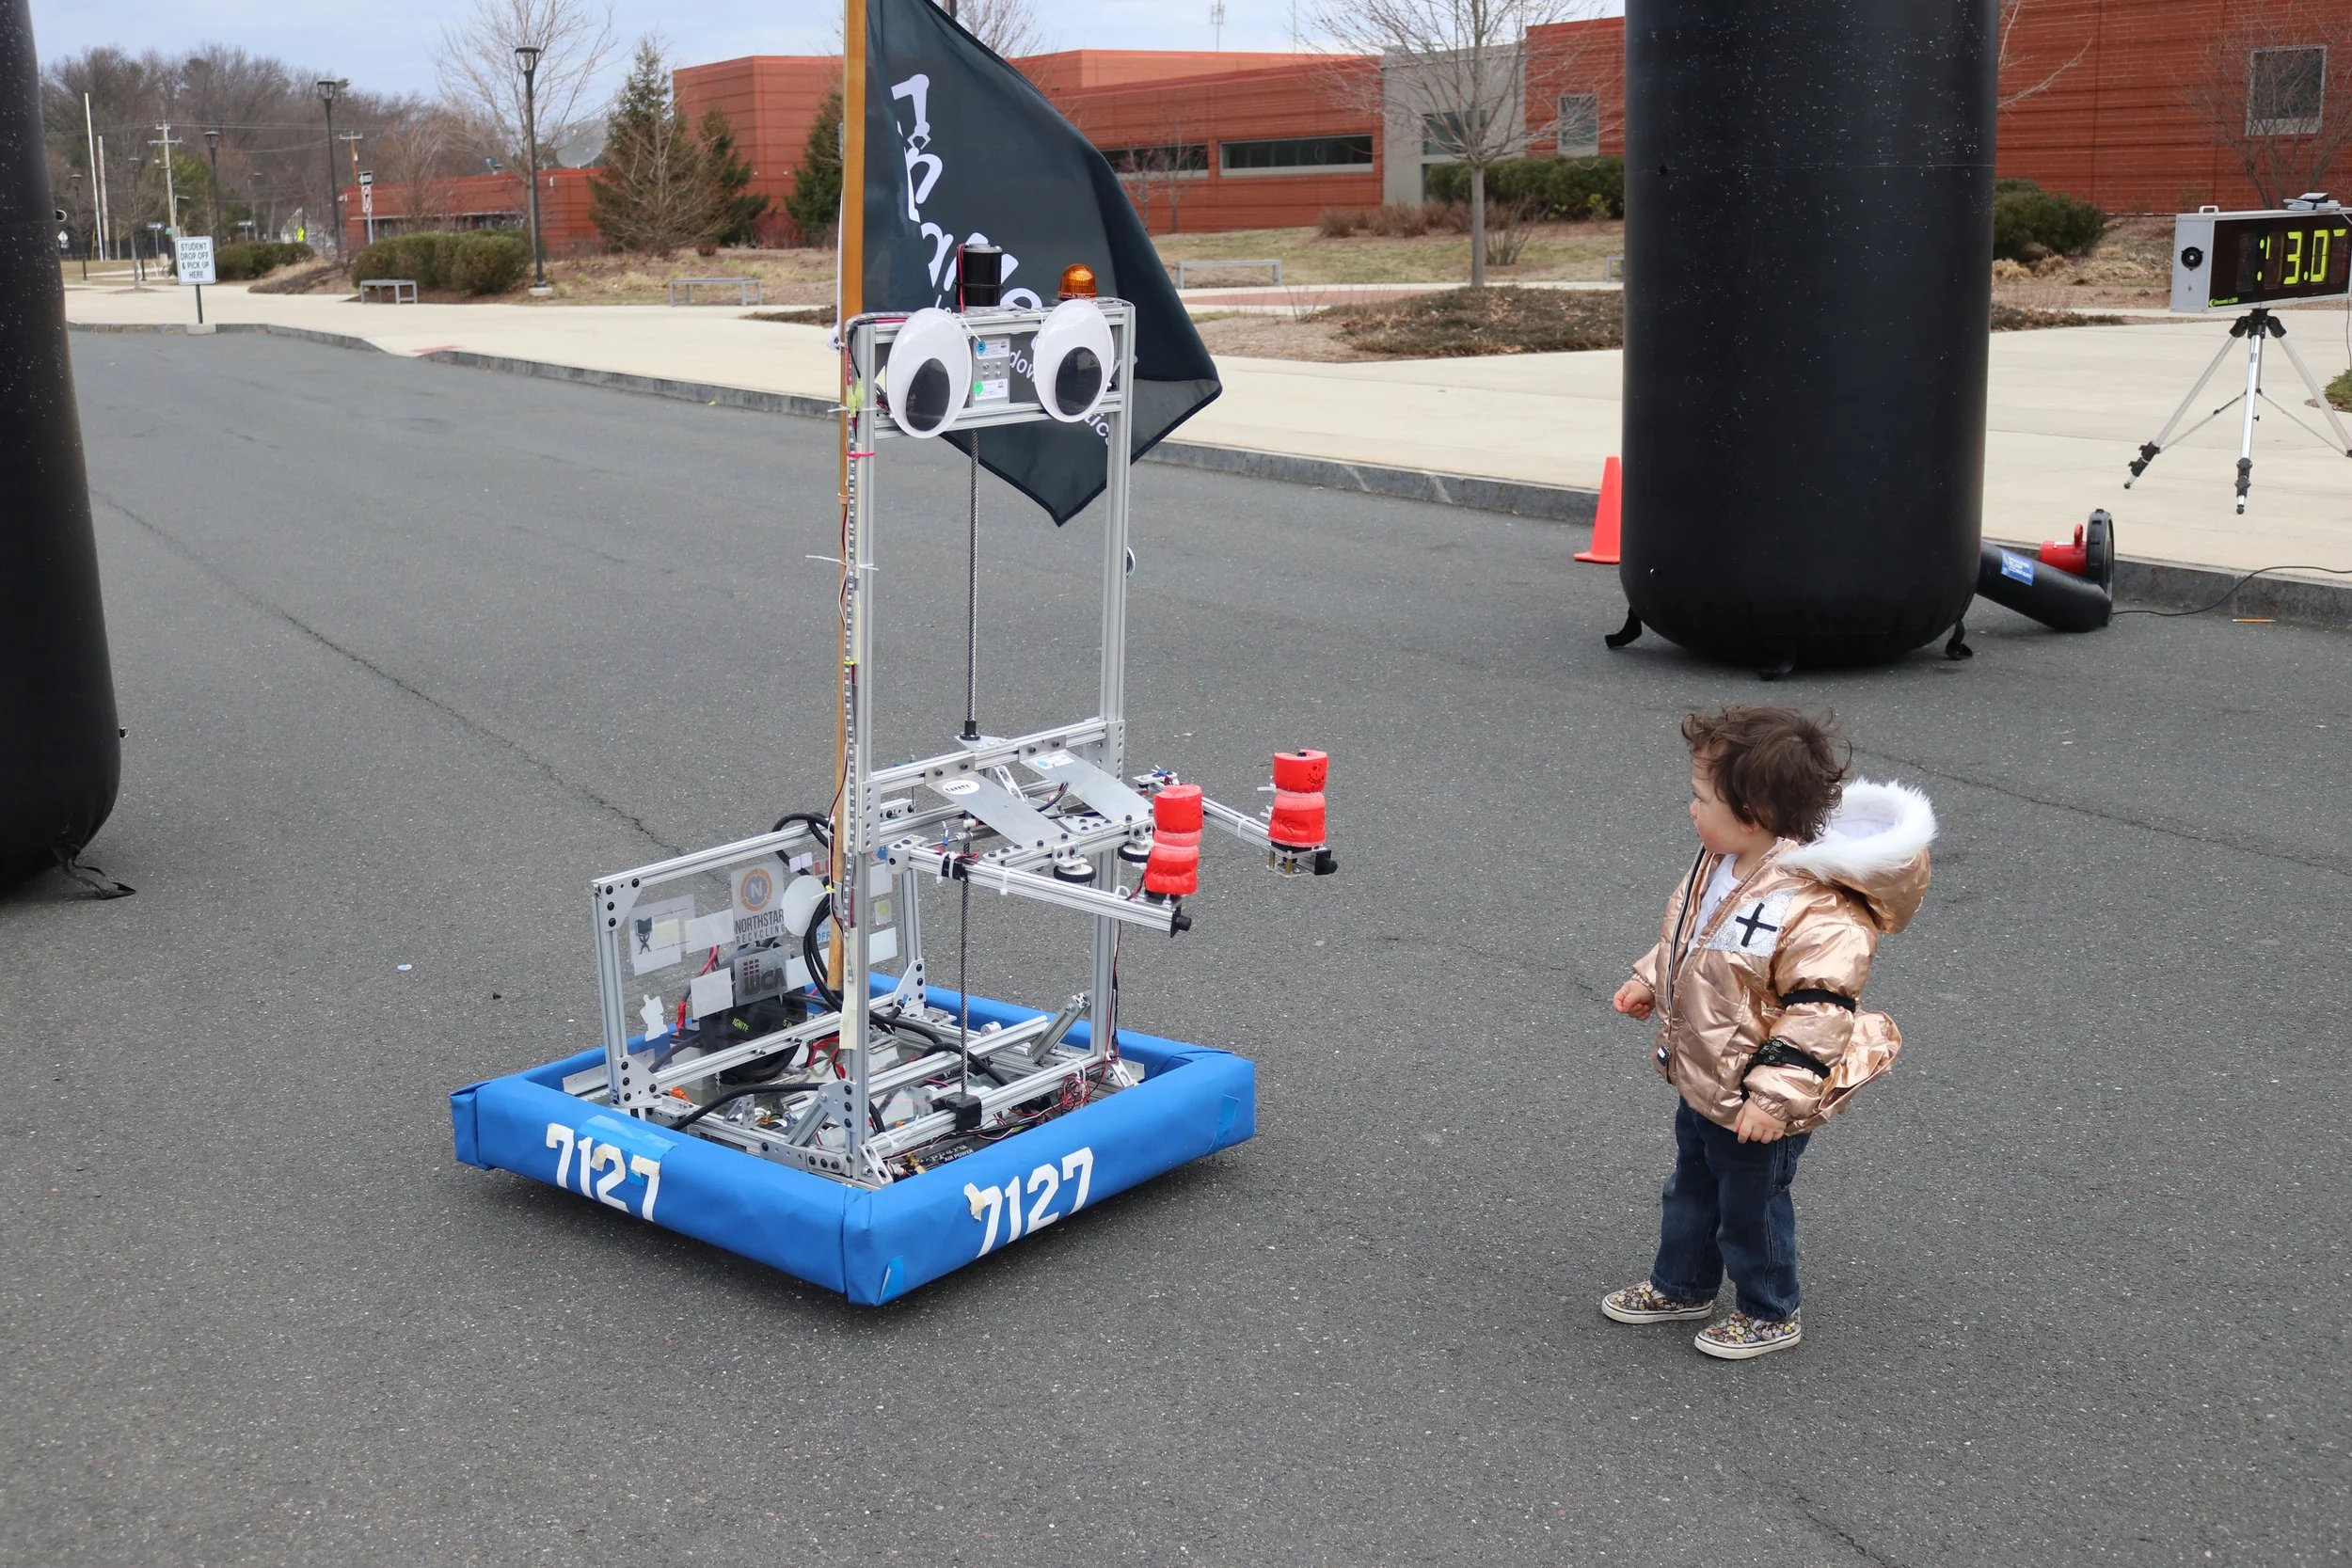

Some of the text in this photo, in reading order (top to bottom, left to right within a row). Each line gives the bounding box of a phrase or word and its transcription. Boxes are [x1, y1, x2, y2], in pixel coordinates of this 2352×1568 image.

[180, 242, 207, 251] STUDENT
[180, 251, 209, 261] DROP OFF
[187, 261, 200, 270] PICK
[202, 261, 210, 269] UP
[189, 270, 204, 279] HERE
[735, 909, 785, 934] NORTHSTAR
[736, 924, 786, 944] RECYCLING
[732, 1017, 749, 1033] IGNITE
[954, 1148, 974, 1159] POWER
[546, 1122, 660, 1222] 7127
[963, 1147, 1093, 1259] 7127
